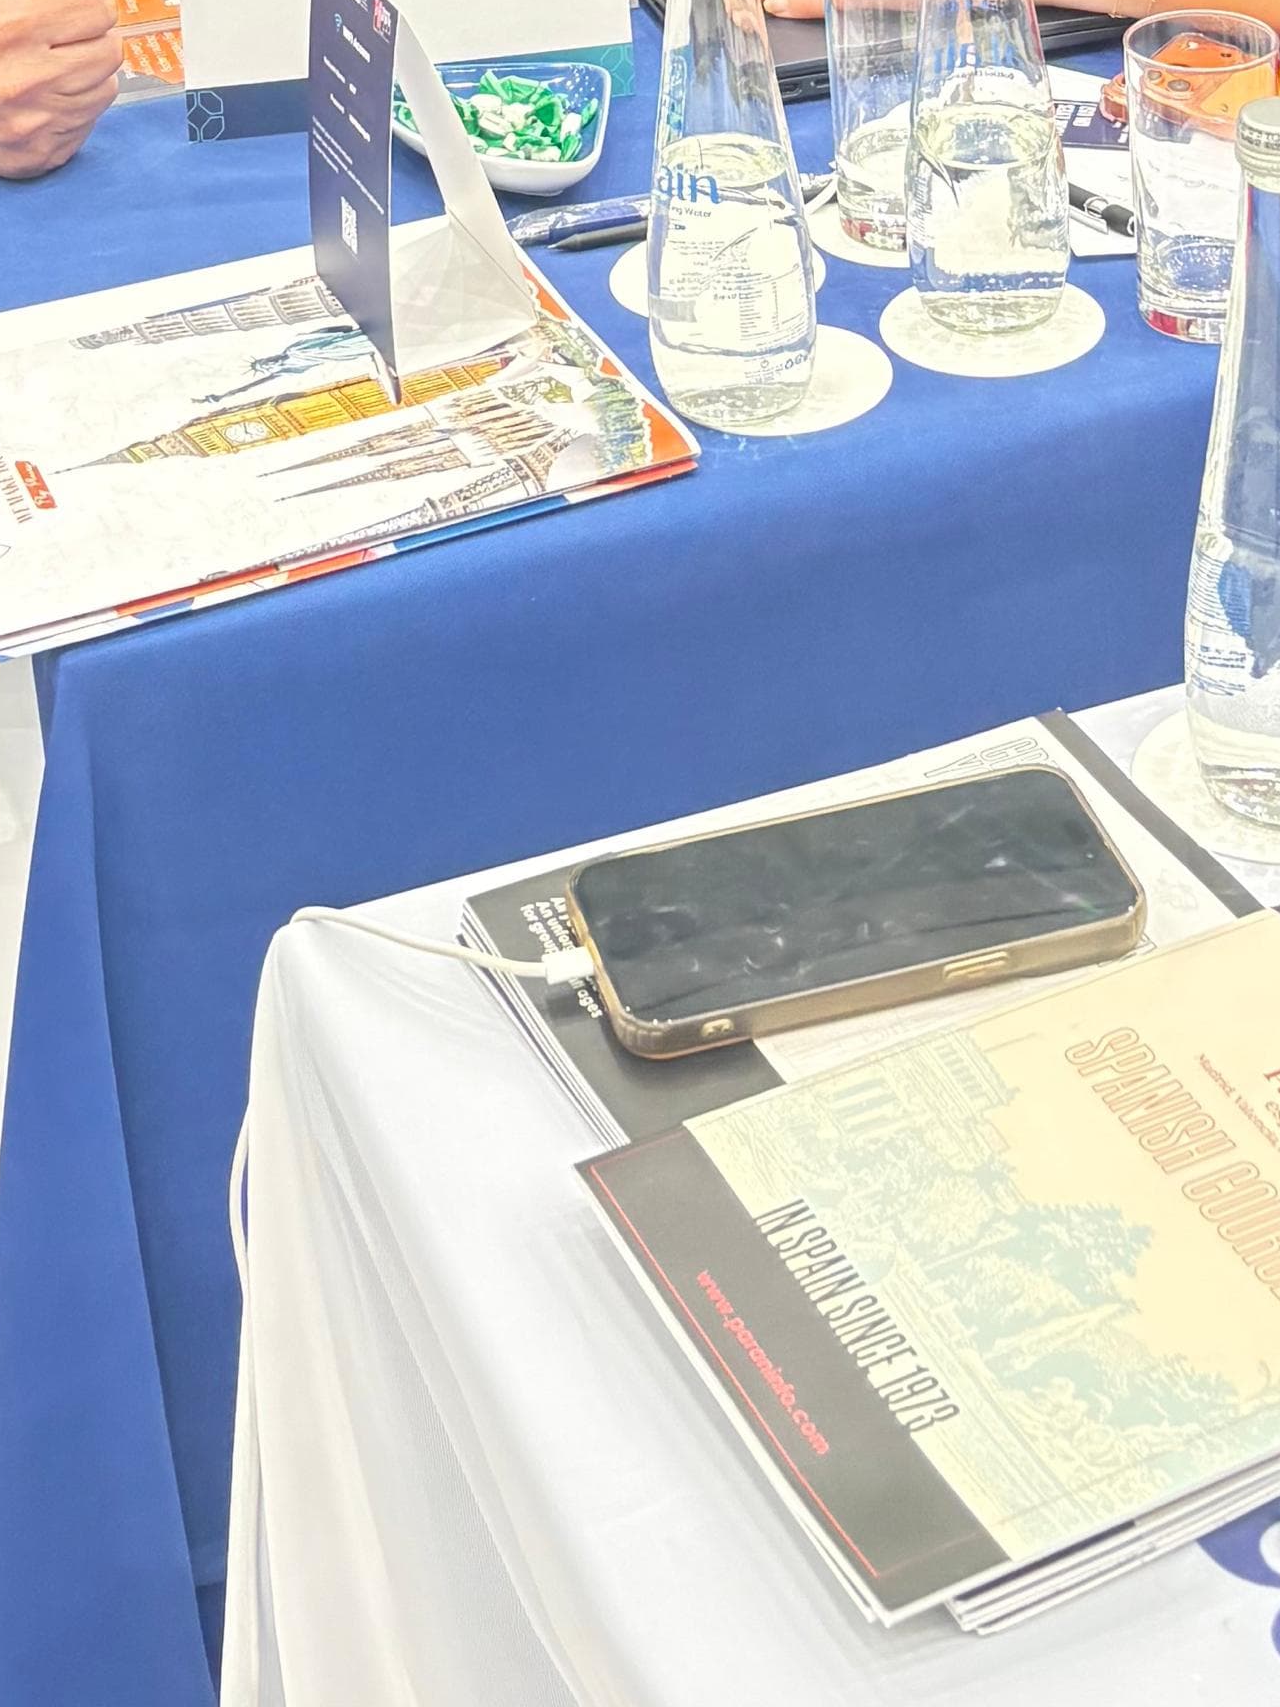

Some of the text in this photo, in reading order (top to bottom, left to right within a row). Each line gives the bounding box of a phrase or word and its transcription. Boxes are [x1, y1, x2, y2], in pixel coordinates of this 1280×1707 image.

[685, 206, 713, 219] Water
[535, 901, 554, 919] An
[519, 903, 540, 922] for
[577, 989, 603, 1019] ages
[1064, 1026, 1238, 1175] SPANISH
[753, 1198, 817, 1240] IN
[776, 1226, 867, 1306] SPAIN
[697, 1269, 830, 1455] www.paraninfo.com
[828, 1294, 918, 1375] SINCE
